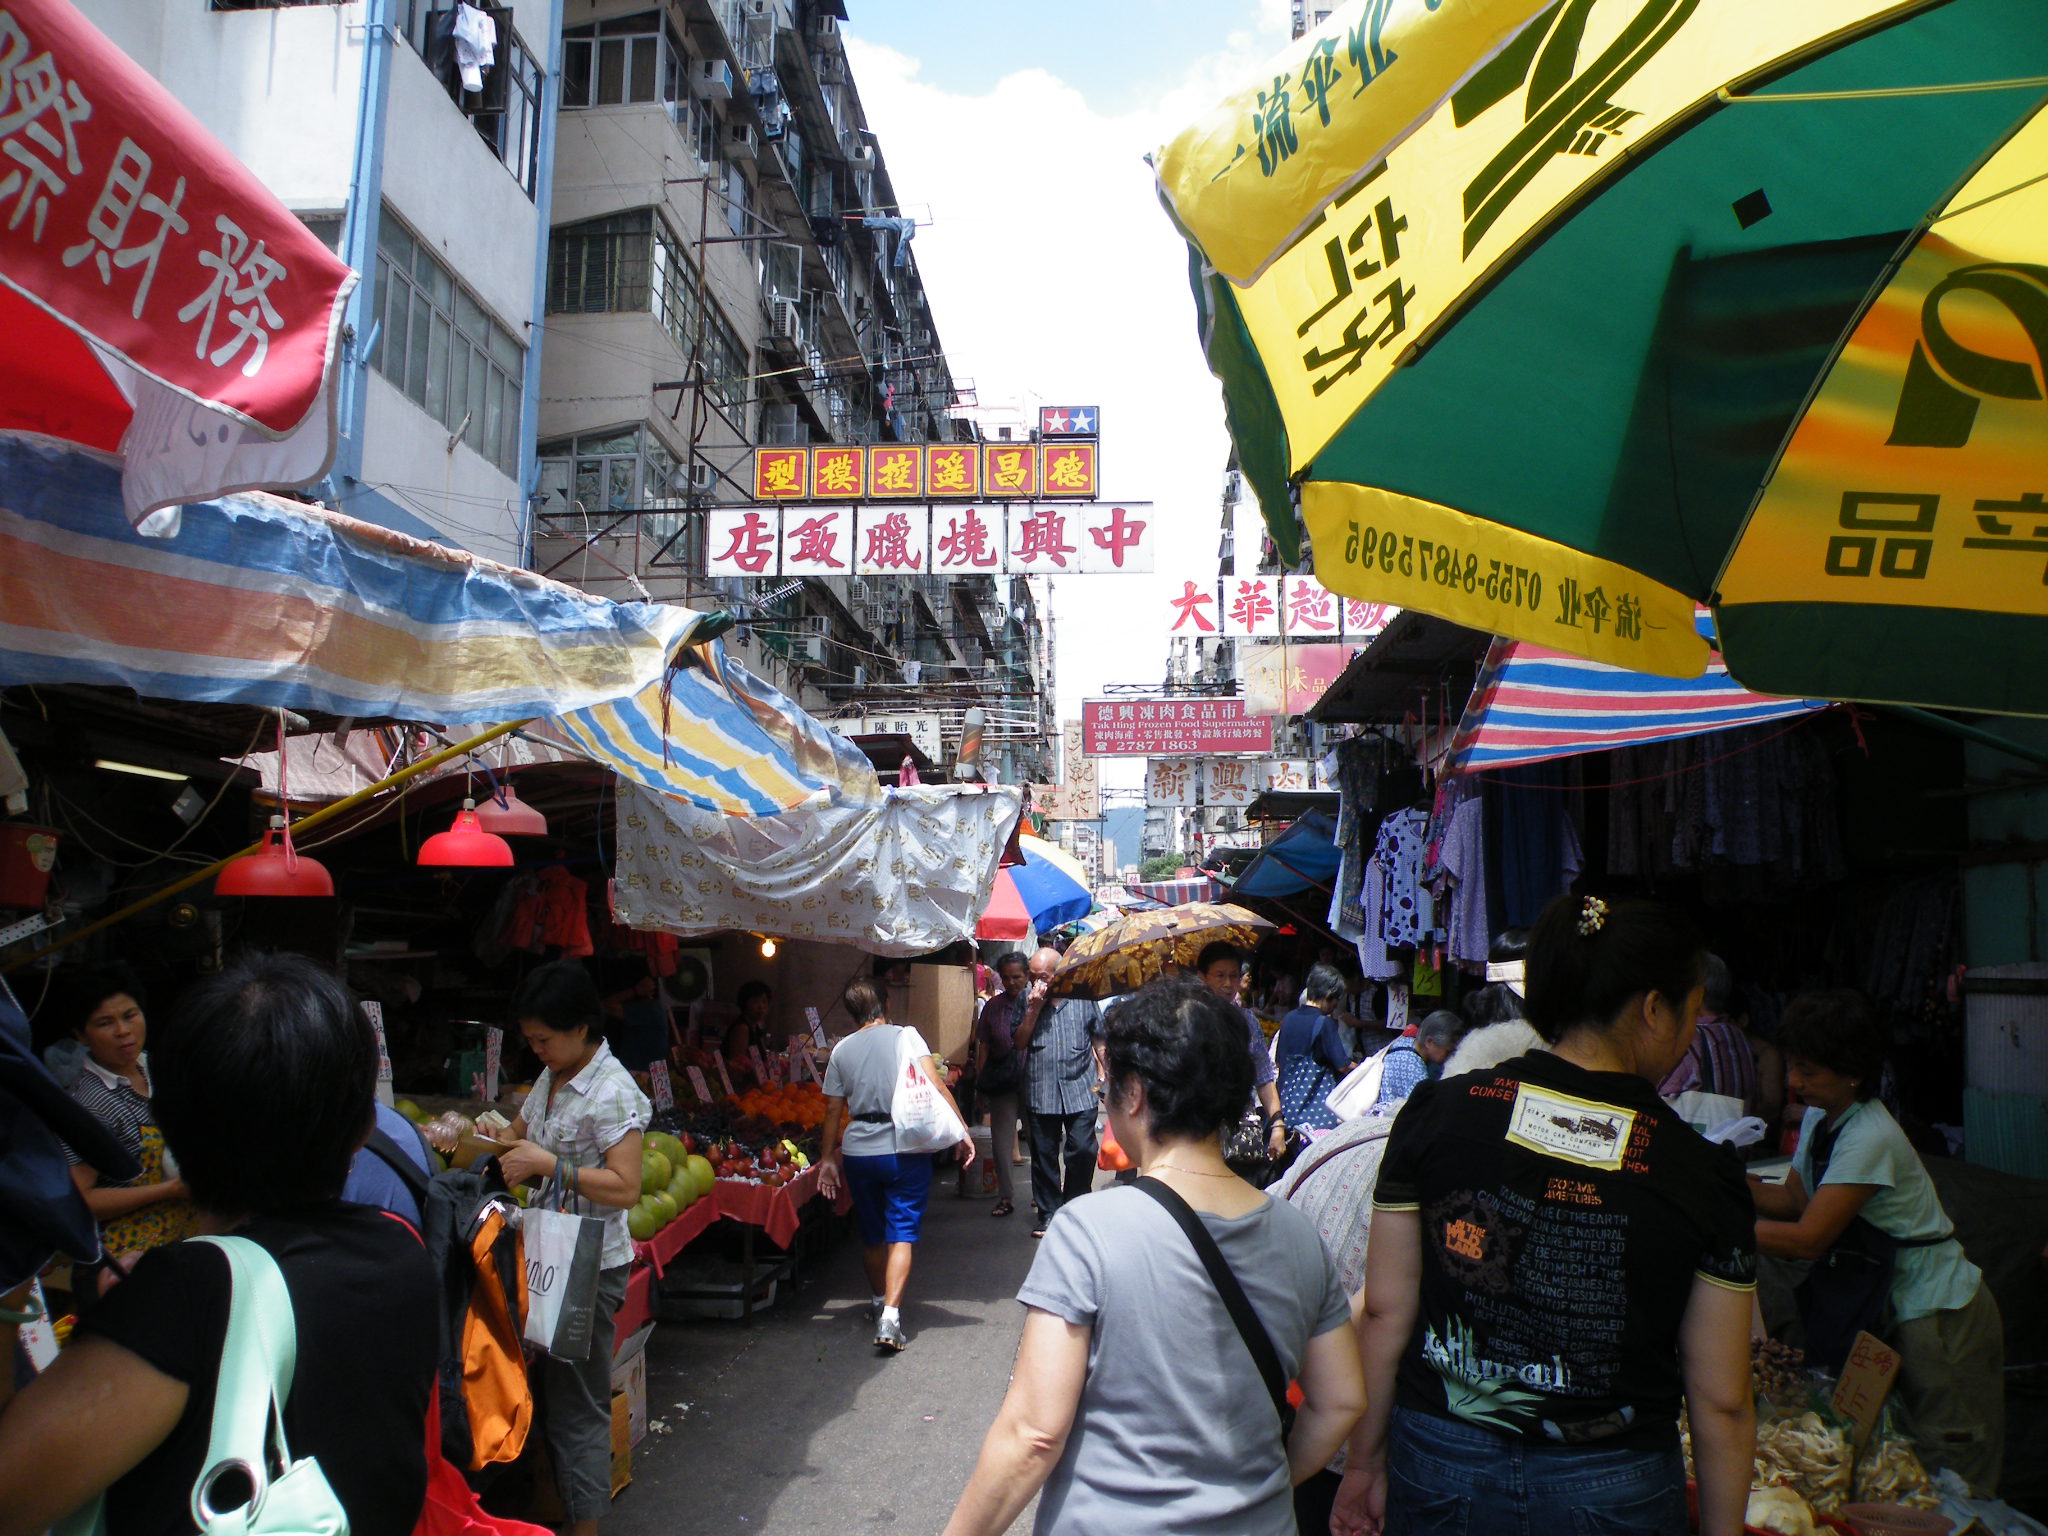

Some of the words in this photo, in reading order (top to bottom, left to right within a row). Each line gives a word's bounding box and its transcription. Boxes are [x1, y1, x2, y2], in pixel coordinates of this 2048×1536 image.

[1091, 722, 1110, 730] Tak
[1112, 721, 1136, 730] Hing
[1138, 721, 1172, 729] Frozen
[1174, 720, 1200, 729] Food
[1202, 720, 1265, 730] Supermarket
[1116, 741, 1154, 752] 2787
[1161, 741, 1198, 751] 1863
[1153, 762, 1328, 803] 新興肉
